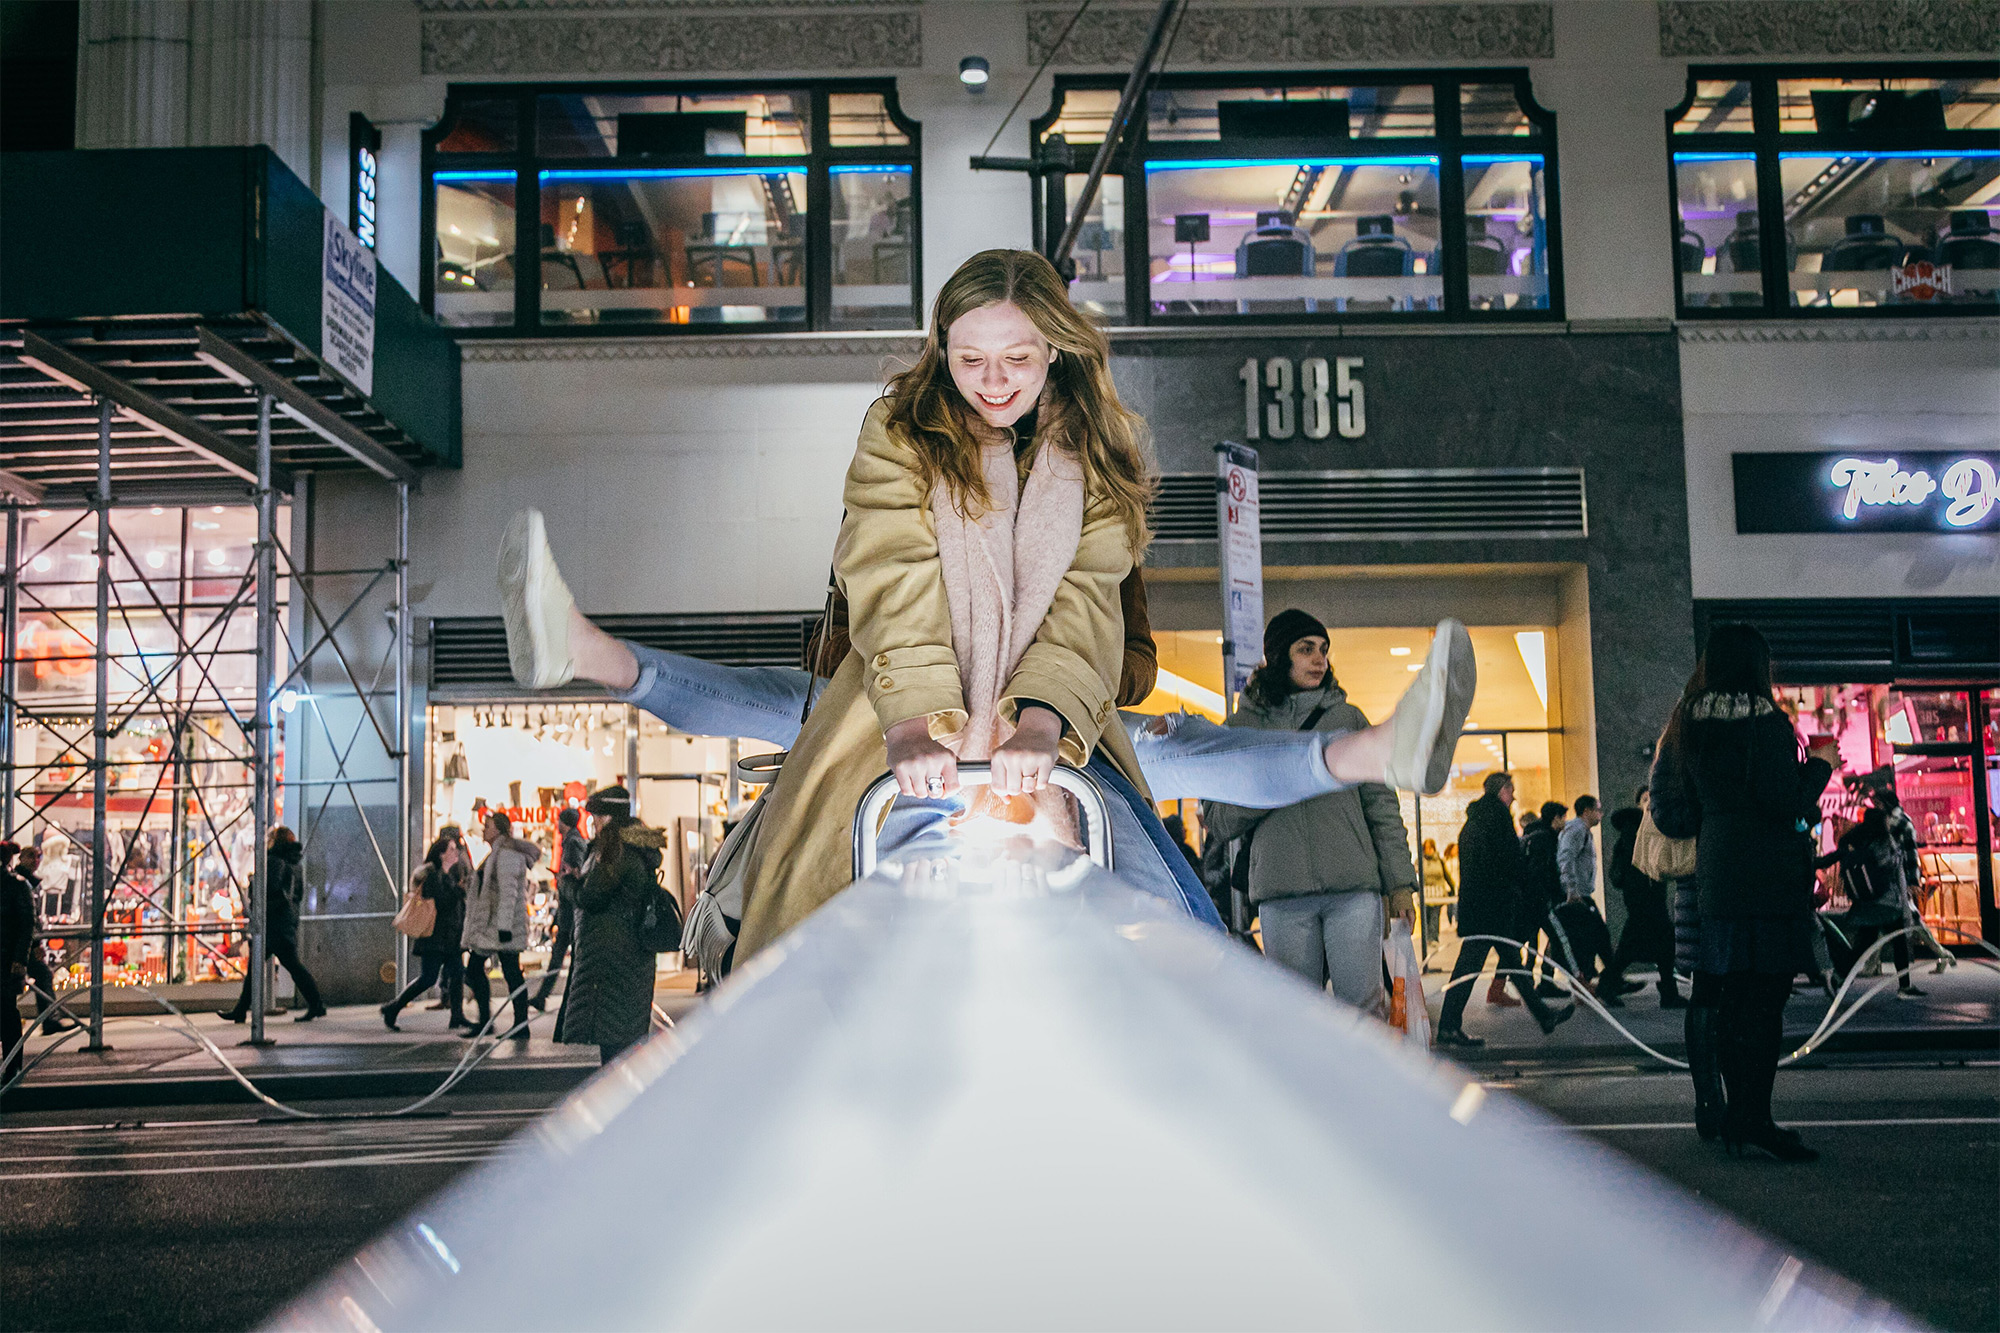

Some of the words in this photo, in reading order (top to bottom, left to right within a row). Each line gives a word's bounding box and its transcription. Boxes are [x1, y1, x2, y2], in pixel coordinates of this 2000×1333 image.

[334, 231, 374, 294] Skyline
[1239, 356, 1366, 440] 1385
[1831, 458, 1937, 519] Taco
[1941, 458, 2000, 527] D
